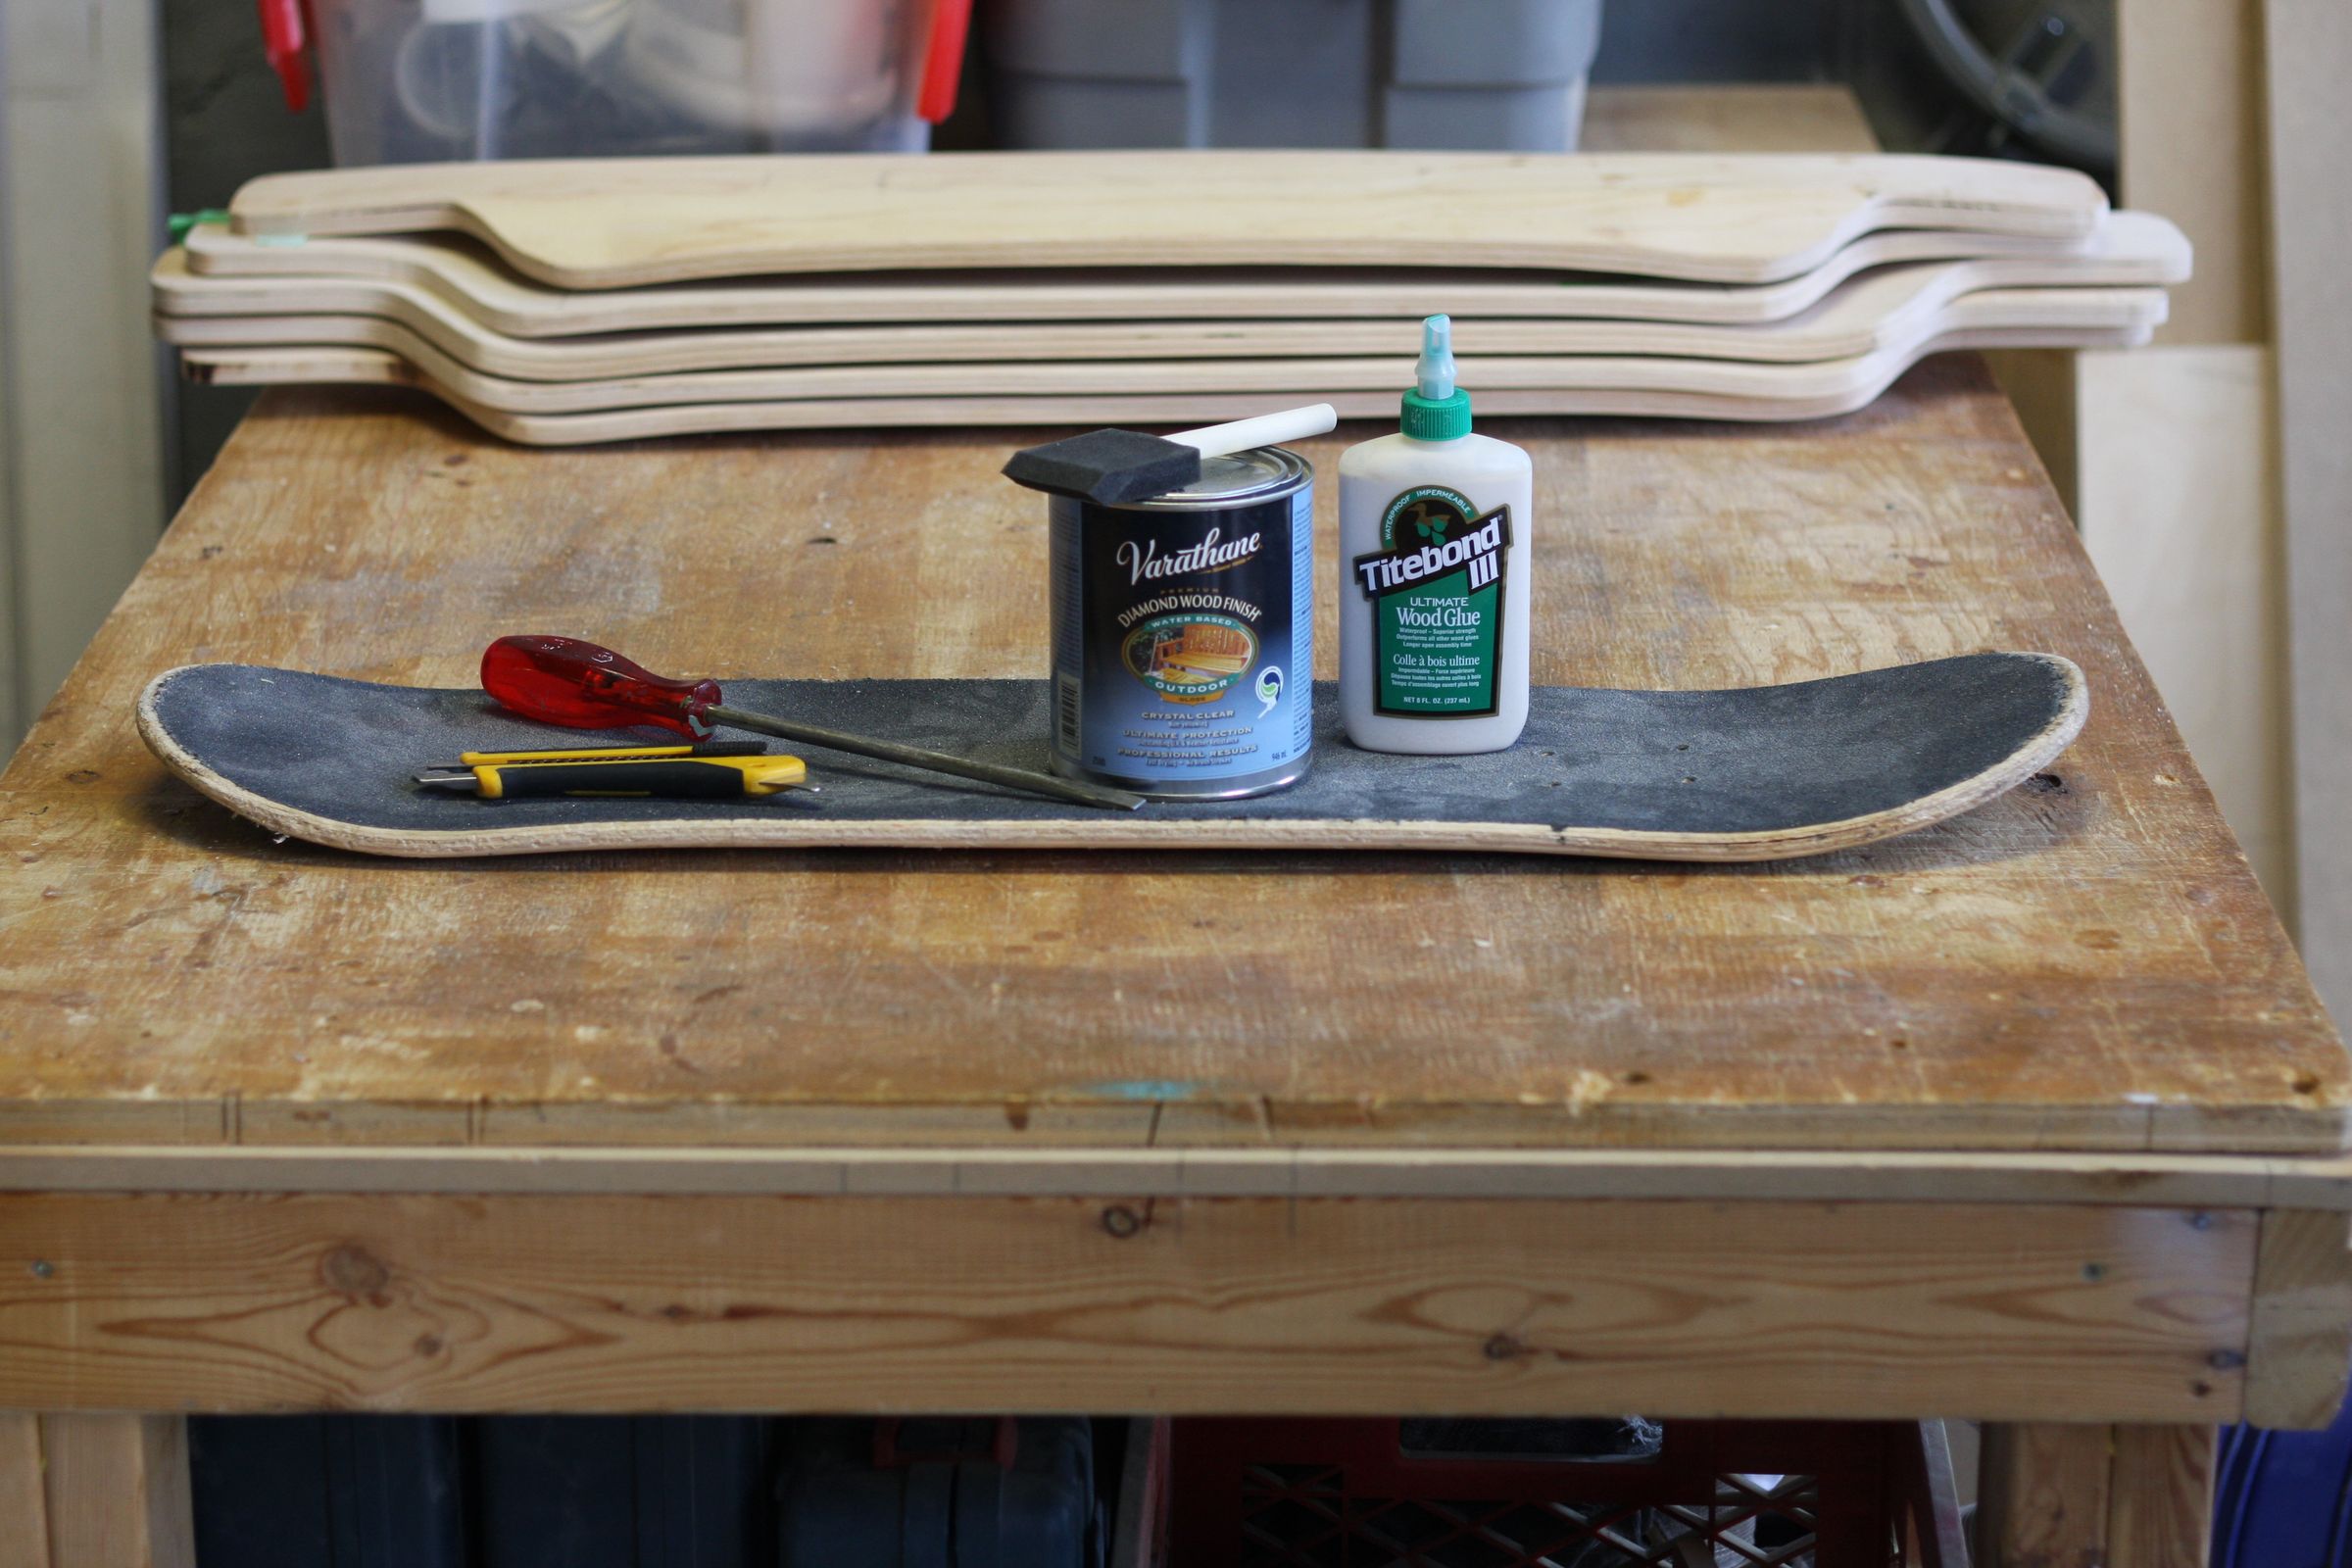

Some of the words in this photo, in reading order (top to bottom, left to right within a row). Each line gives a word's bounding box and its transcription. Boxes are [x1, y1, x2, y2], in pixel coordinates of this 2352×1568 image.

[1415, 489, 1471, 514] IMPERMÉABLE
[1383, 495, 1412, 539] WATERPROOF
[1116, 527, 1260, 586] Varathane
[1359, 516, 1501, 592] Titebond
[1469, 551, 1499, 590] III
[1409, 597, 1469, 607] ULTIMATE
[1117, 596, 1179, 628] DIAMOND
[1180, 594, 1224, 610] WOOD
[1396, 607, 1443, 626] Wood
[1444, 608, 1481, 626] Glue
[1151, 616, 1194, 629] WATER
[1196, 615, 1232, 626] BASED
[1393, 654, 1417, 666] Colle
[1418, 655, 1426, 666] à
[1427, 655, 1447, 666] bois
[1449, 655, 1481, 666] ultime
[1154, 679, 1229, 695] OUTDOOR
[1141, 711, 1194, 720] CRYSTAL
[1196, 710, 1235, 719] CLEAR
[1122, 729, 1178, 739] ULTIMATE
[1182, 726, 1253, 739] PROTECTION
[1117, 748, 1205, 759] PROFESSIONAL
[1209, 745, 1257, 758] RESULTS
